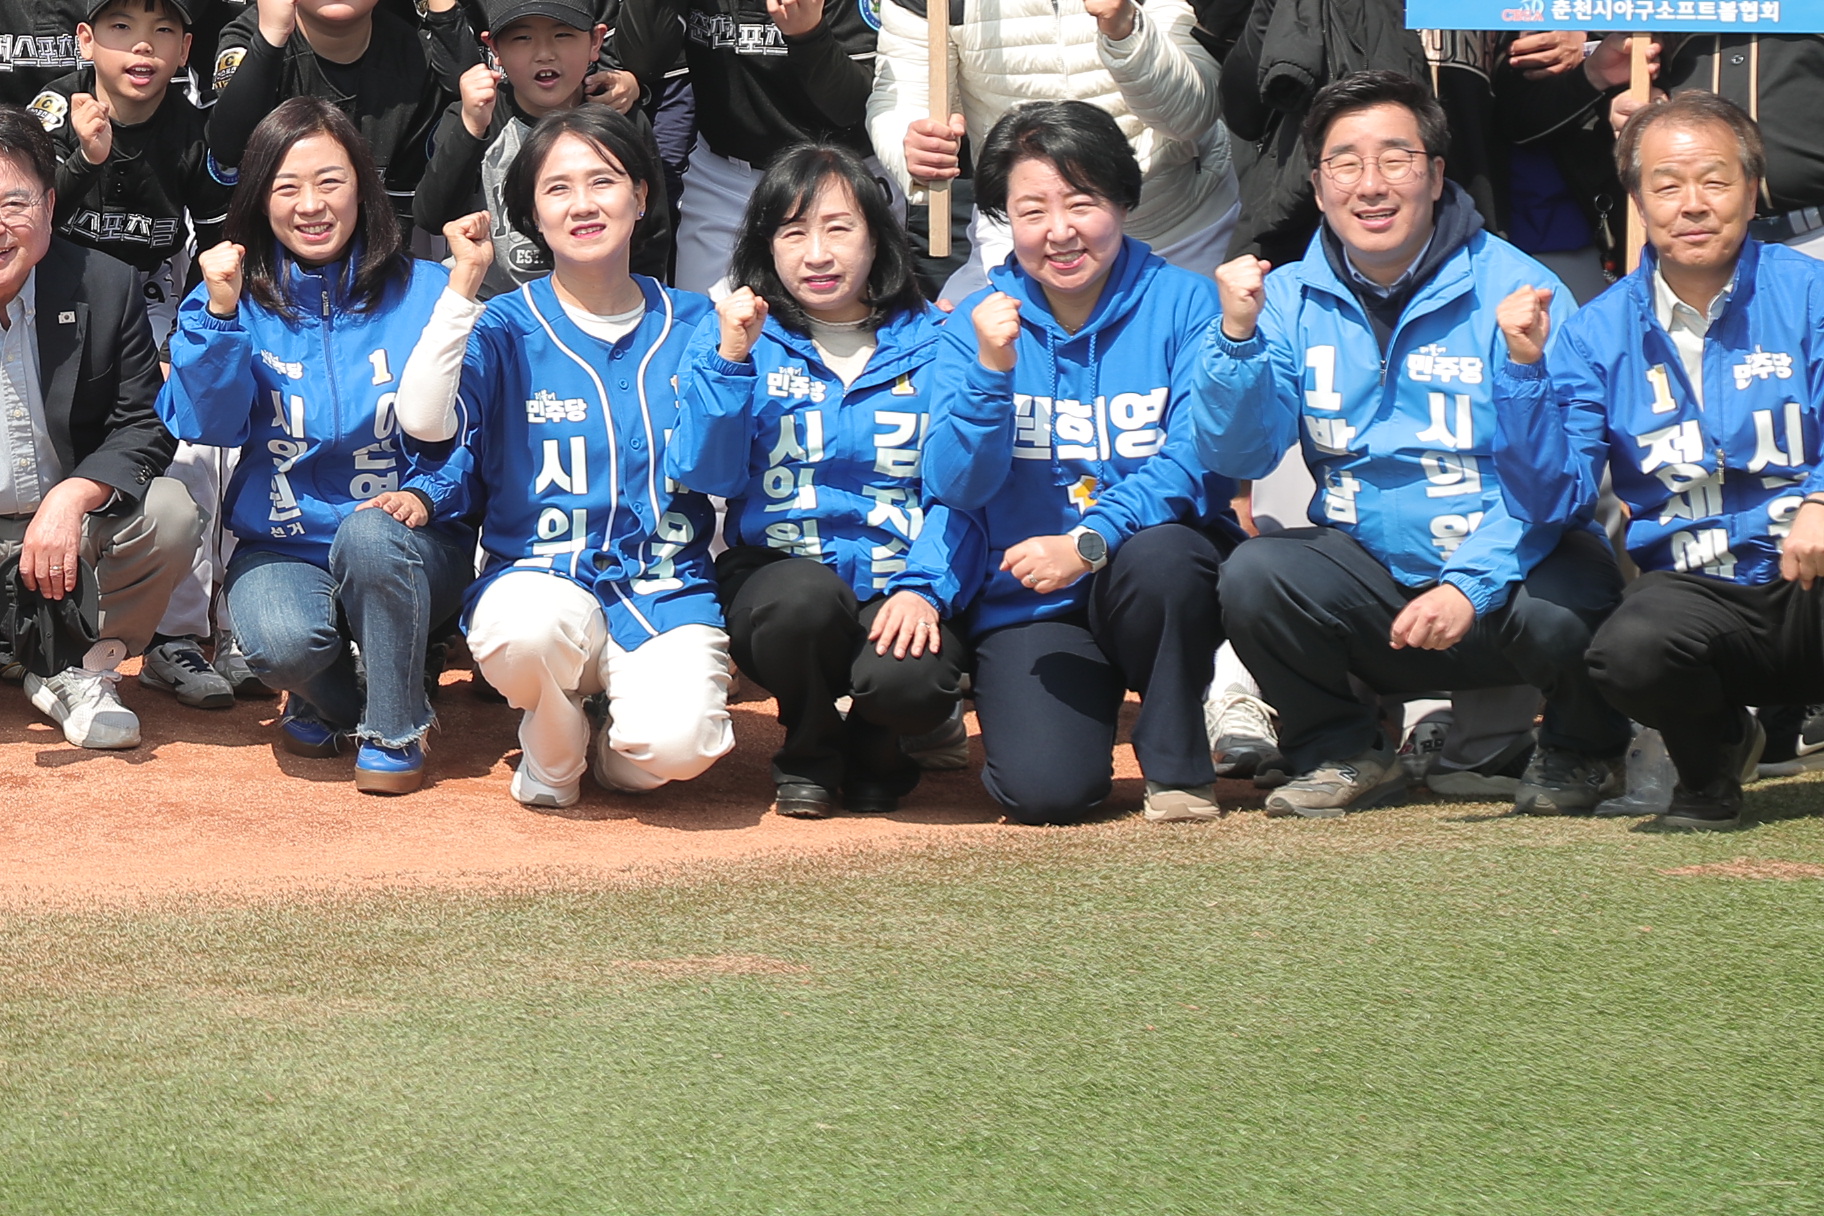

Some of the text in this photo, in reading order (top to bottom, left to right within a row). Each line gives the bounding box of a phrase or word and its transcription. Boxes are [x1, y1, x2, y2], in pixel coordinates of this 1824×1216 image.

[368, 348, 394, 385] 1
[1305, 345, 1342, 411] 1
[1407, 353, 1484, 384] 민주당
[767, 372, 826, 403] 민주당
[1645, 363, 1677, 414] 1
[525, 398, 588, 423] 민주당
